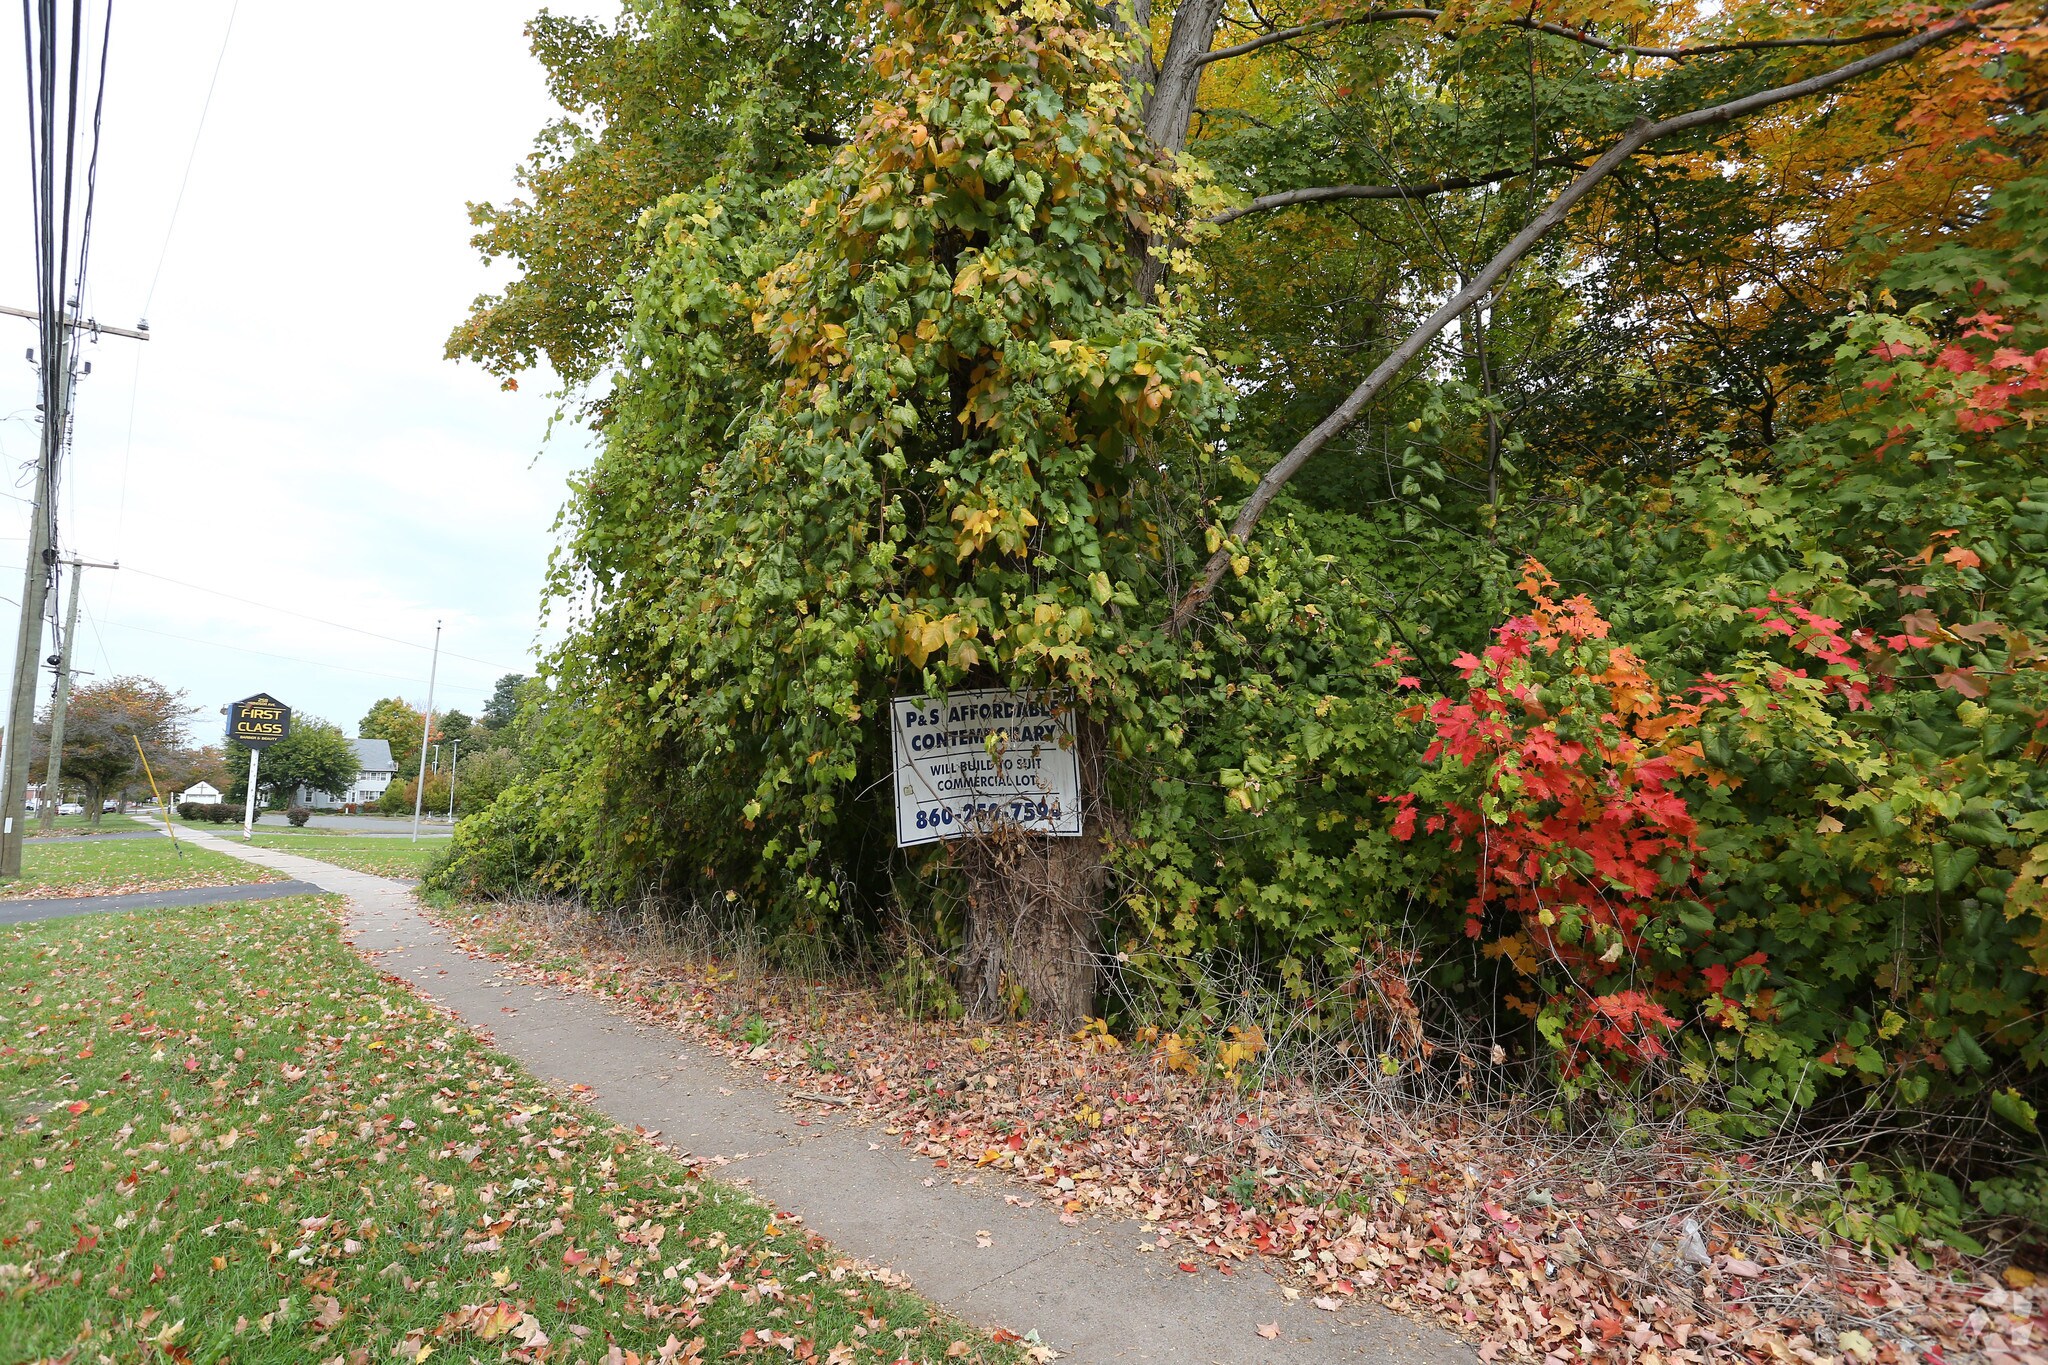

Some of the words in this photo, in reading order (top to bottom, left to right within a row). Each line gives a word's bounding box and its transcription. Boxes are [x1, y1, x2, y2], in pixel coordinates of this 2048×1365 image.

[241, 709, 282, 720] FIRST
[906, 708, 940, 728] P&S
[948, 700, 1059, 723] AFFORDABLE
[238, 722, 282, 734] CLASS
[930, 764, 956, 777] WILL
[960, 759, 994, 772] BUILD
[1016, 757, 1042, 770] SUIT
[937, 775, 1013, 791] COMMERCIAL
[1015, 774, 1036, 787] LOT
